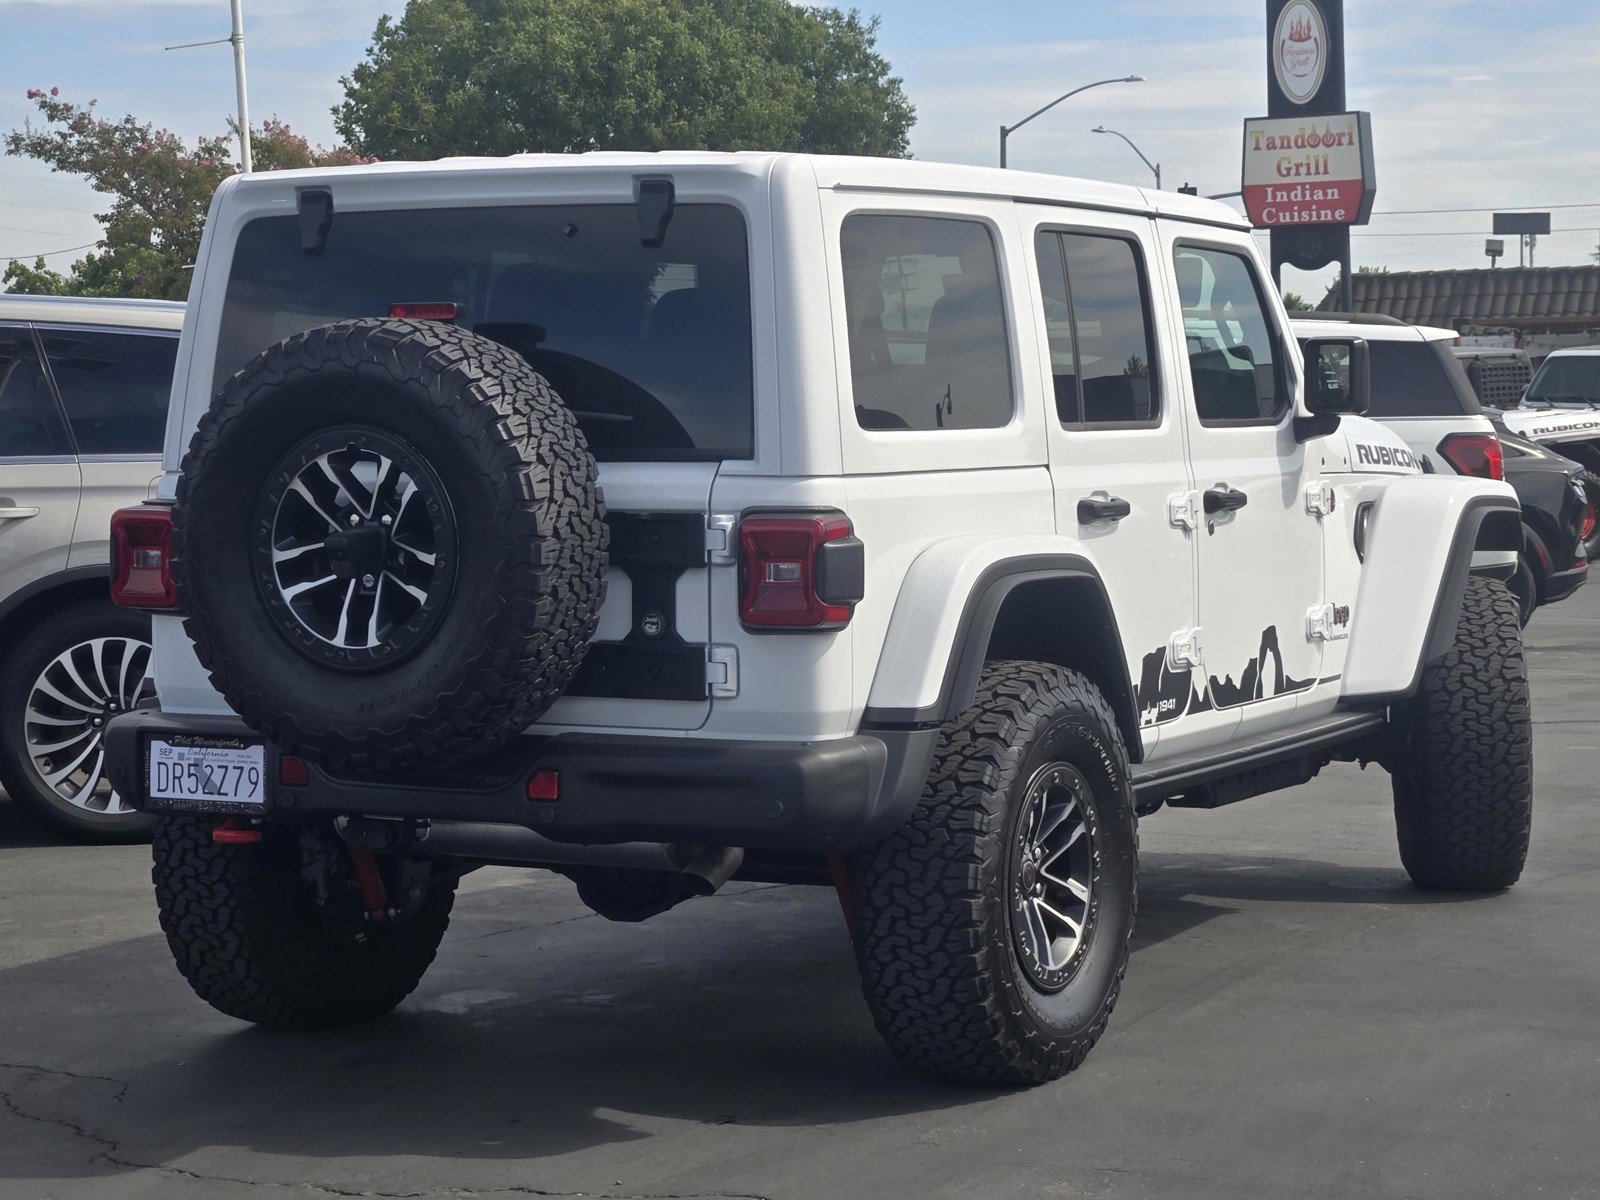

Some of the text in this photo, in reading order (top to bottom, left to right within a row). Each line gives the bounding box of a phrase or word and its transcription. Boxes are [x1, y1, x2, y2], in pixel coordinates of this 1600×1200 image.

[1250, 123, 1355, 151] Tandoori
[1276, 153, 1330, 178] Grill
[1265, 184, 1340, 203] Indian
[1262, 205, 1346, 224] Cuisine
[1355, 444, 1421, 470] RUBICON
[1159, 698, 1176, 712] 1941
[159, 747, 173, 756] SEP
[187, 747, 230, 759] California
[157, 761, 260, 798] DR52Z79
